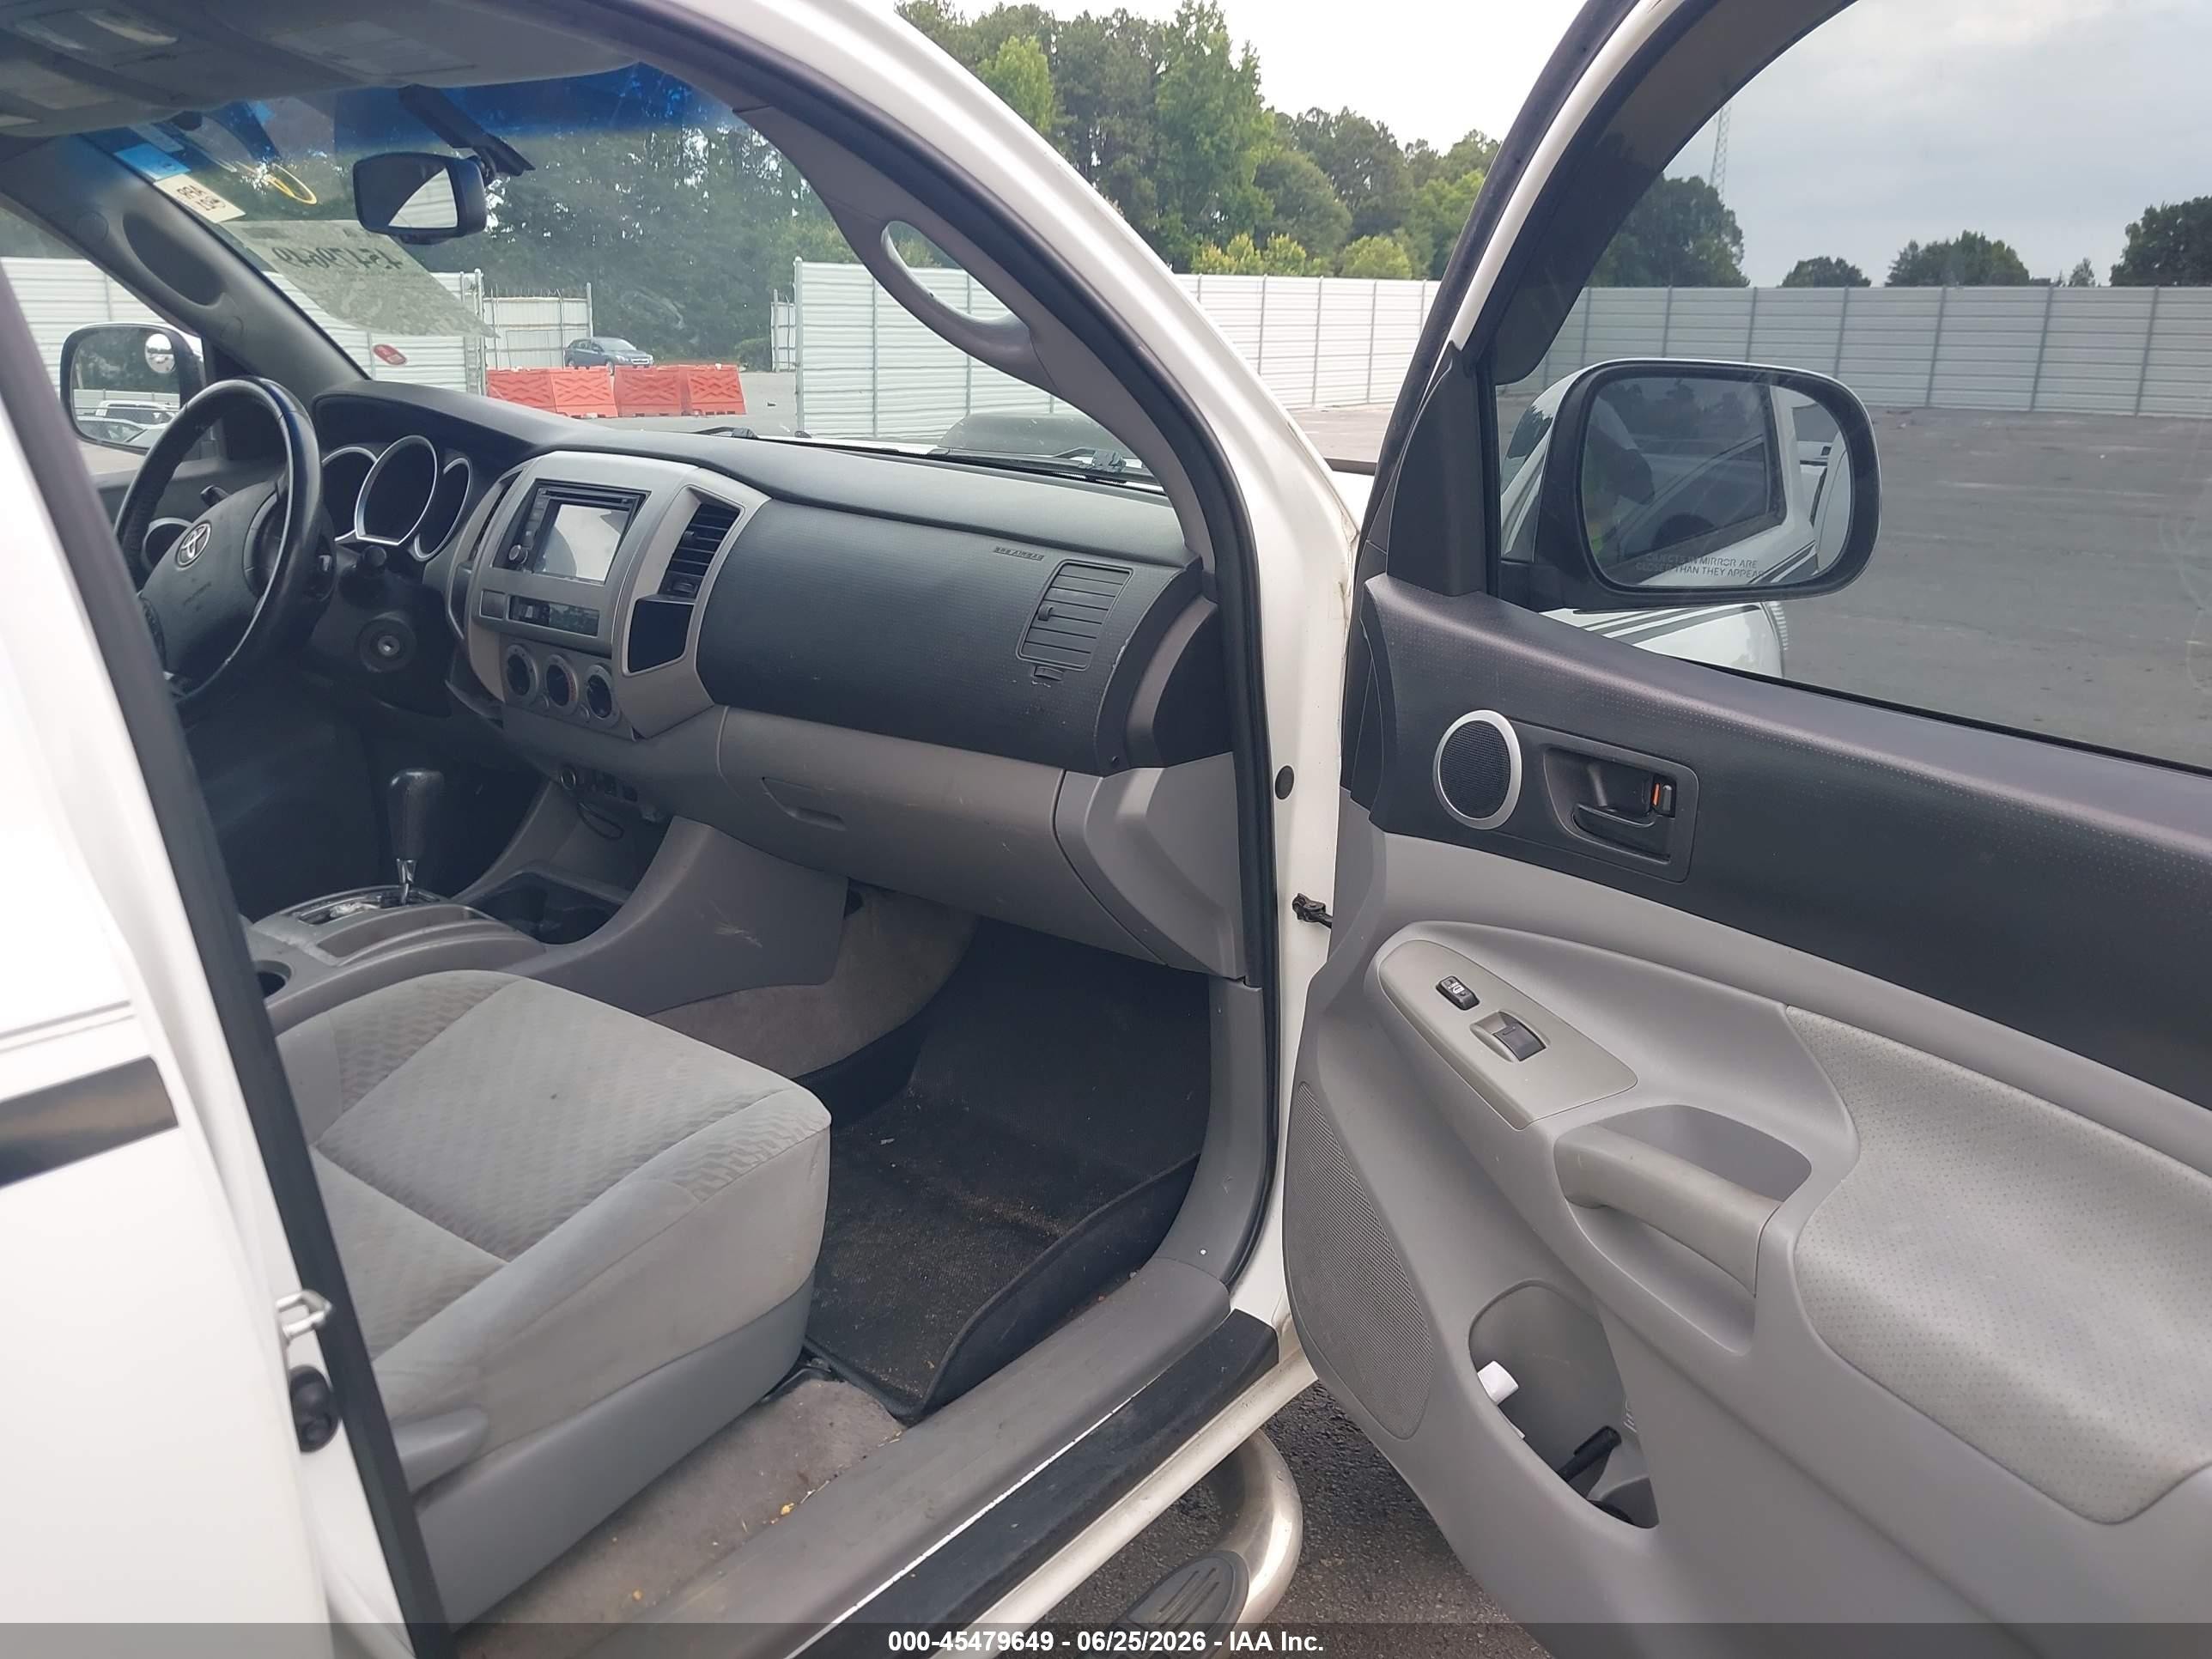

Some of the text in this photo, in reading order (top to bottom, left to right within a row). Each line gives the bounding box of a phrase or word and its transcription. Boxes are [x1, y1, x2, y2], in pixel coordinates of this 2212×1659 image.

[1699, 556, 1735, 567] MIRROR
[1739, 559, 1758, 568] ARE
[1674, 565, 1699, 574] THAN
[1702, 566, 1726, 576] THEY
